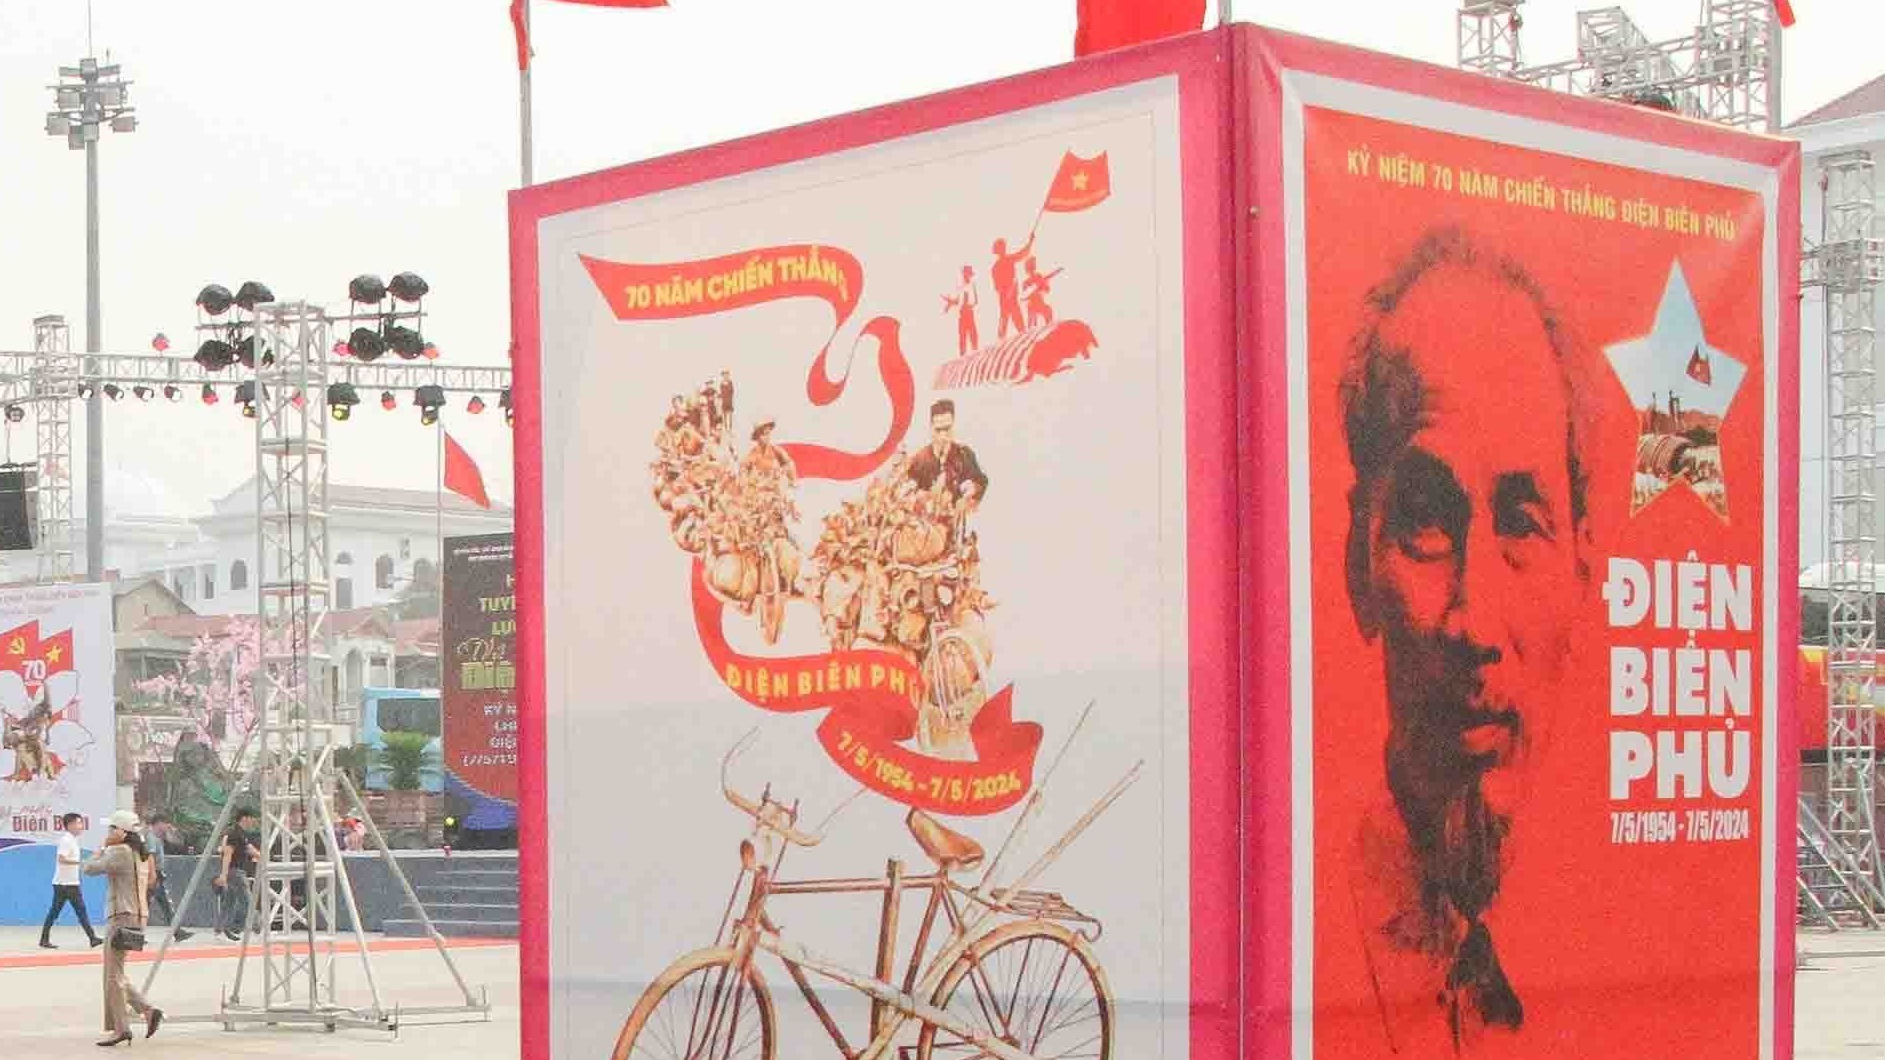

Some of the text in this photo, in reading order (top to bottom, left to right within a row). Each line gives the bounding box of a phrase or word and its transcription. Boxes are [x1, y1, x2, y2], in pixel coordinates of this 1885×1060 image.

[1379, 151, 1428, 188] NIỆM
[1433, 164, 1453, 191] 70
[1504, 175, 1556, 211] CHIẾN
[1562, 182, 1617, 221] THẮNG
[1621, 197, 1660, 230] ĐIỆN
[1665, 203, 1700, 236] BIÊN
[1705, 211, 1738, 242] PHỦ
[624, 285, 651, 310] 70
[655, 275, 704, 307] NĂM
[707, 255, 774, 301] CHIẾN
[1602, 550, 1752, 640] ĐIỆN
[21, 659, 47, 680] 70
[725, 662, 790, 702] ĐIỆN
[797, 661, 862, 695] BIÊN
[1610, 638, 1752, 717] BIÊN
[931, 771, 1021, 802] 7/5/2024
[1609, 717, 1752, 800] PHỦ
